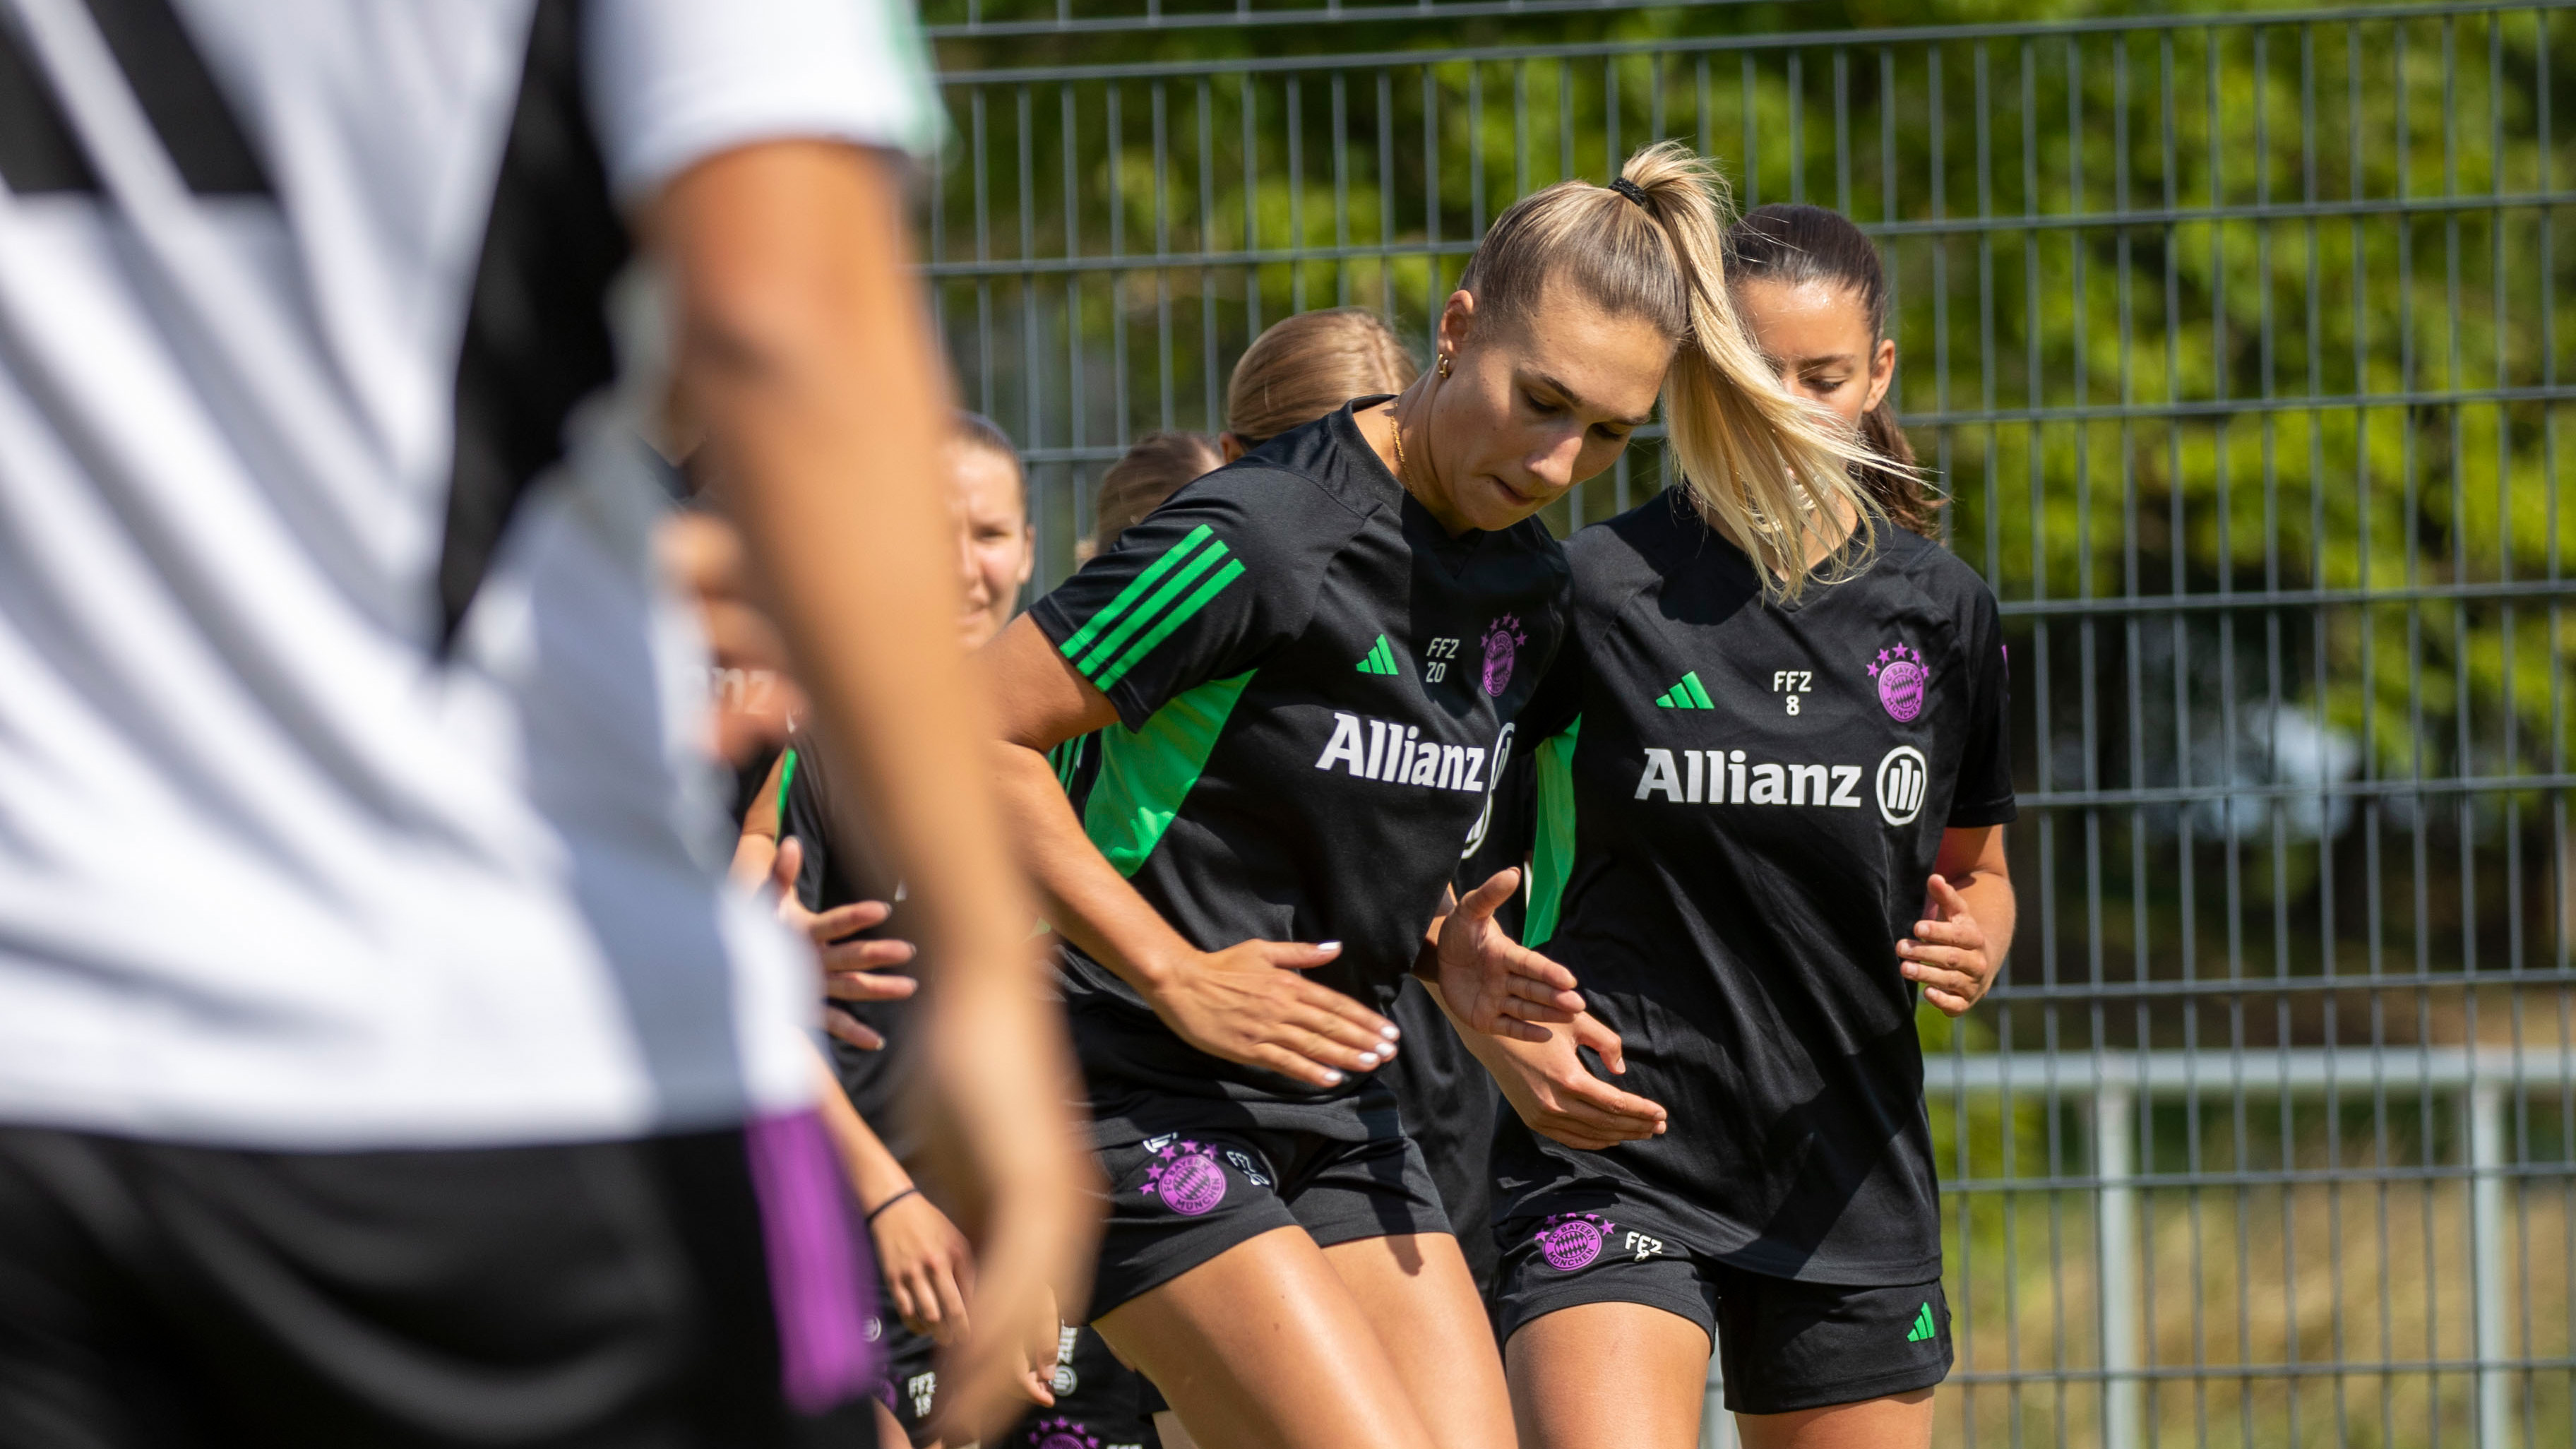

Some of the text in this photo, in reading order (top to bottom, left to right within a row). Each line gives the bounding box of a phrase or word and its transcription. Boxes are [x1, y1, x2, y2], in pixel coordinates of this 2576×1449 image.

[1425, 637, 1460, 660] FFZ
[1425, 662, 1446, 684] 20
[1772, 671, 1813, 693] FFZ
[1883, 667, 1921, 688] FC BAYERN
[1785, 695, 1800, 716] 8
[1315, 712, 1485, 792] Allianz
[1634, 748, 1862, 808] Allianz
[1164, 1158, 1210, 1191] FC BAYERN
[1549, 1224, 1597, 1244] FC BAYERN
